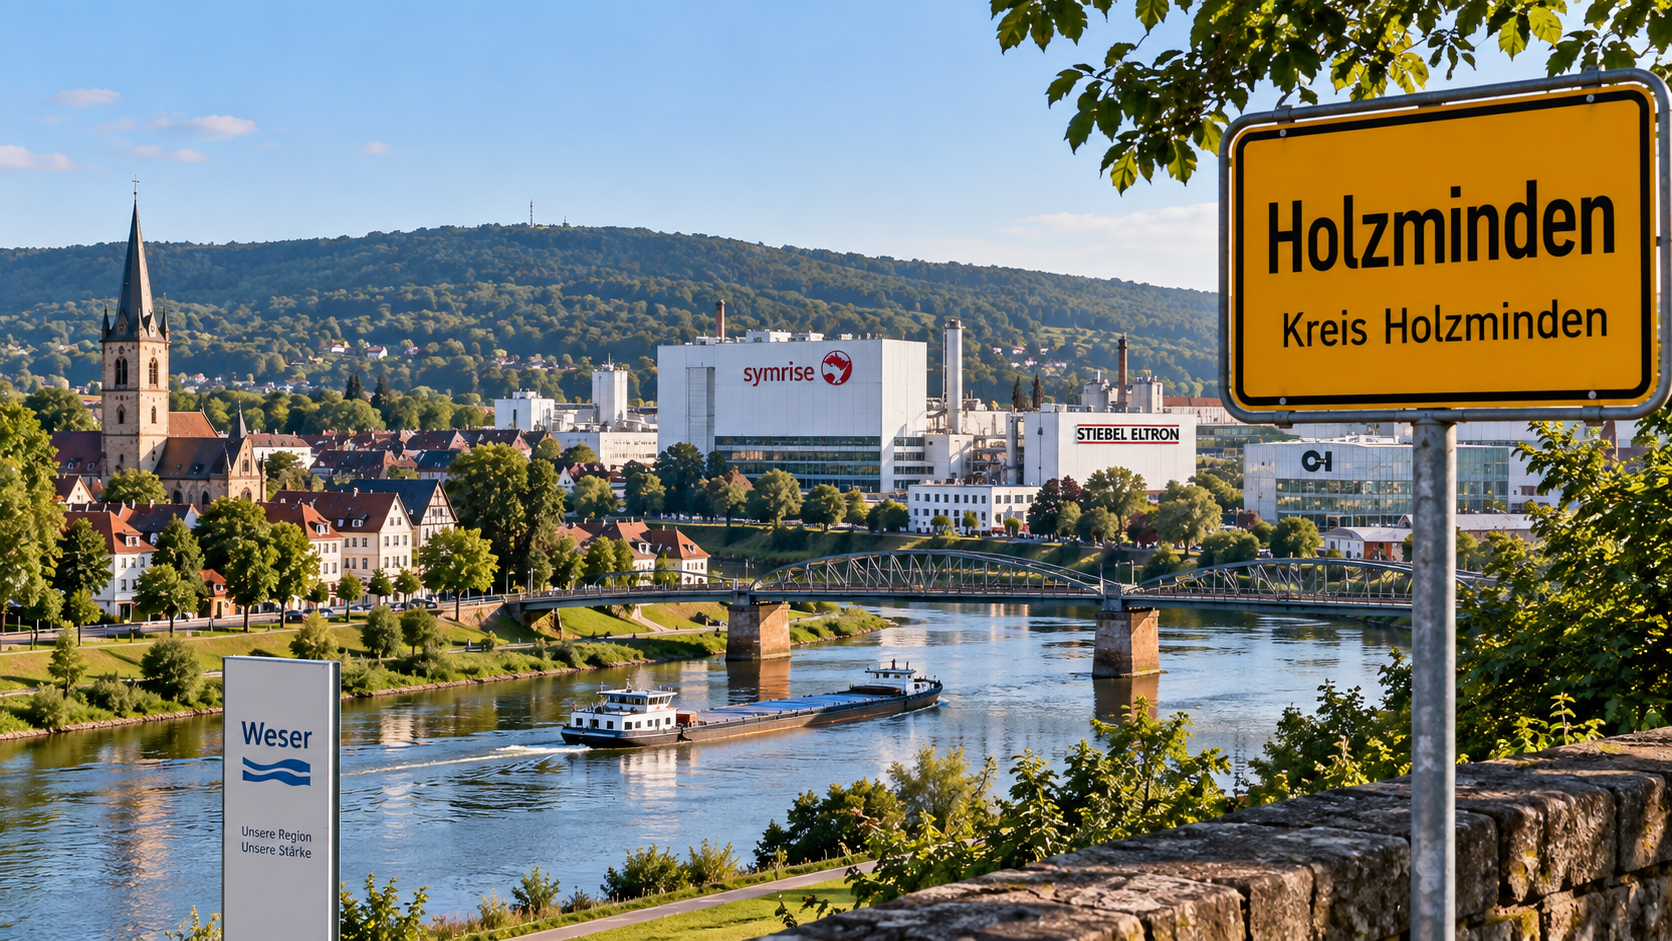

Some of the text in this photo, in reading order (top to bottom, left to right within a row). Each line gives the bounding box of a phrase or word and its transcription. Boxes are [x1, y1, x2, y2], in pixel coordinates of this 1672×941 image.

[1268, 179, 1615, 275] Holzminden
[1283, 299, 1608, 348] Kreis Holzminden
[743, 361, 815, 387] symrise
[1077, 427, 1179, 441] STIEBEL ELTRON
[241, 720, 313, 750] Weser
[241, 825, 312, 844] Unsere Region
[241, 841, 276, 856] Unsere
